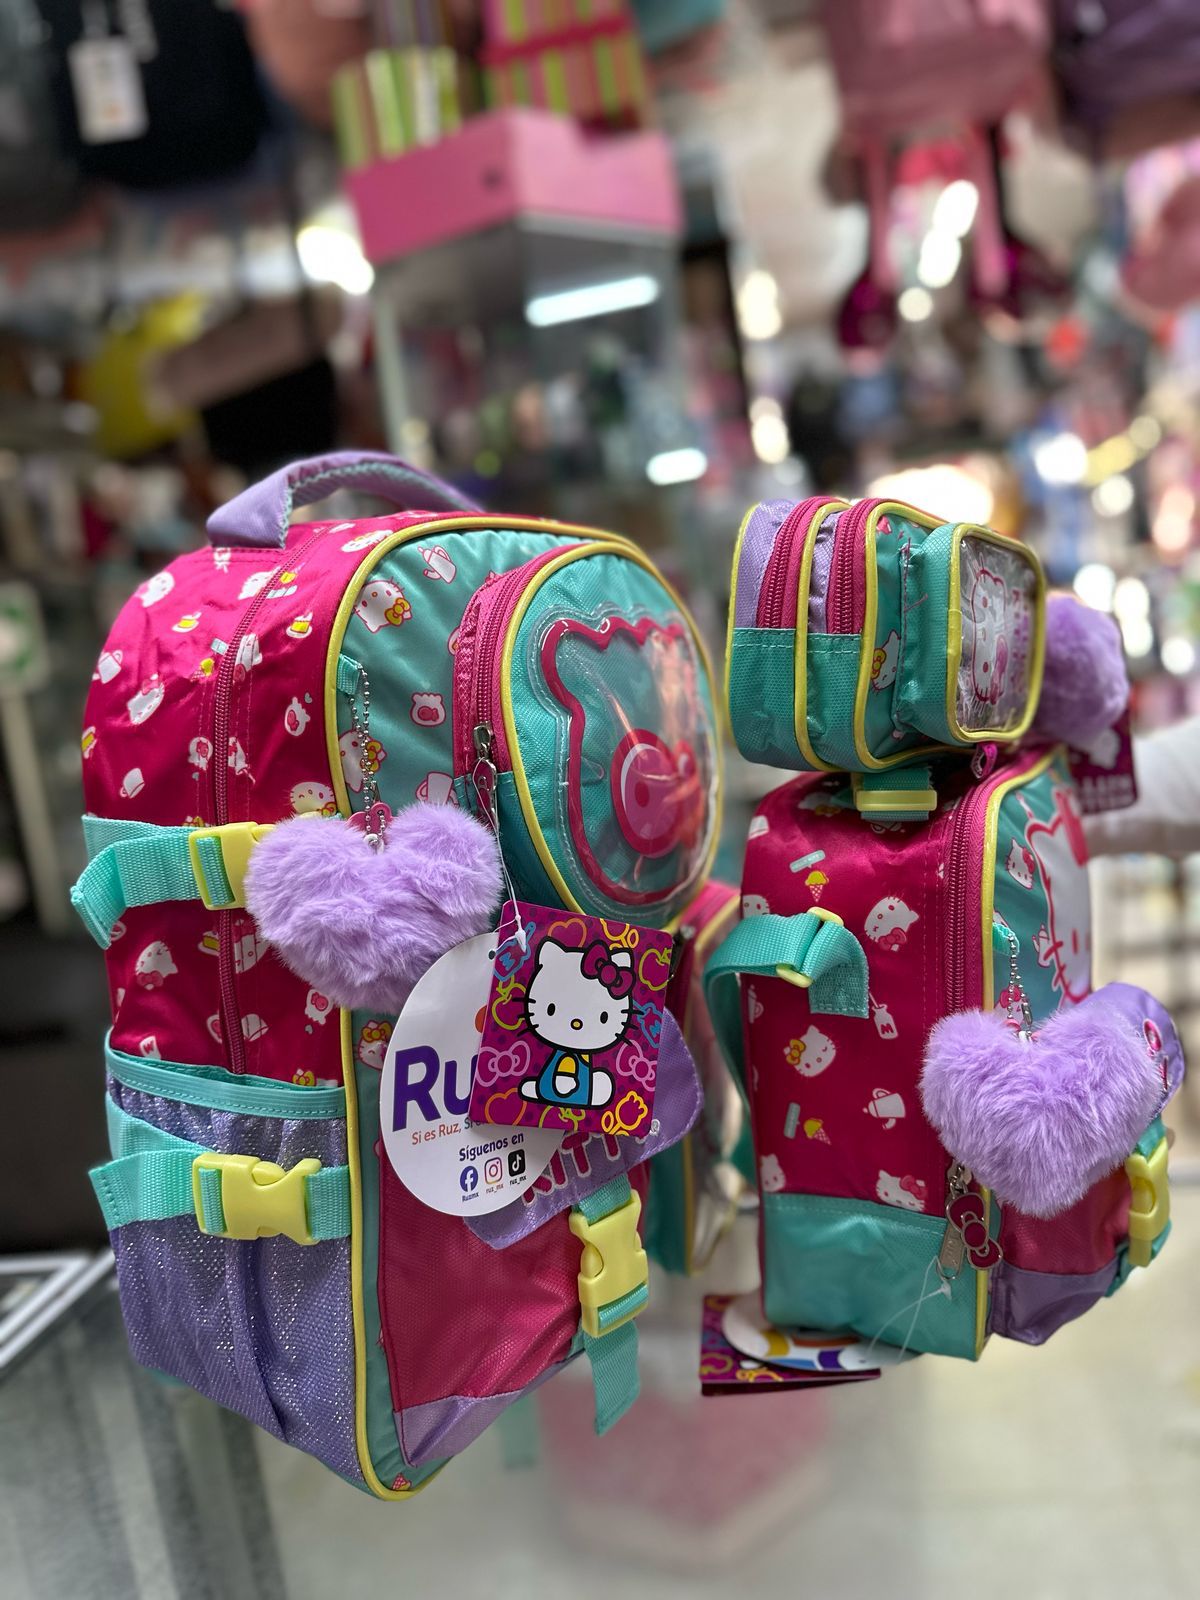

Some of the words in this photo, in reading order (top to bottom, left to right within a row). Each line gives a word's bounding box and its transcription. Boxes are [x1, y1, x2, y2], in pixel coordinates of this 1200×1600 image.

[392, 1045, 478, 1132] Ru
[411, 1130, 422, 1145] Si
[424, 1130, 437, 1141] es
[439, 1123, 462, 1138] Ruz,
[459, 1137, 508, 1162] Síguenos
[511, 1132, 525, 1145] en
